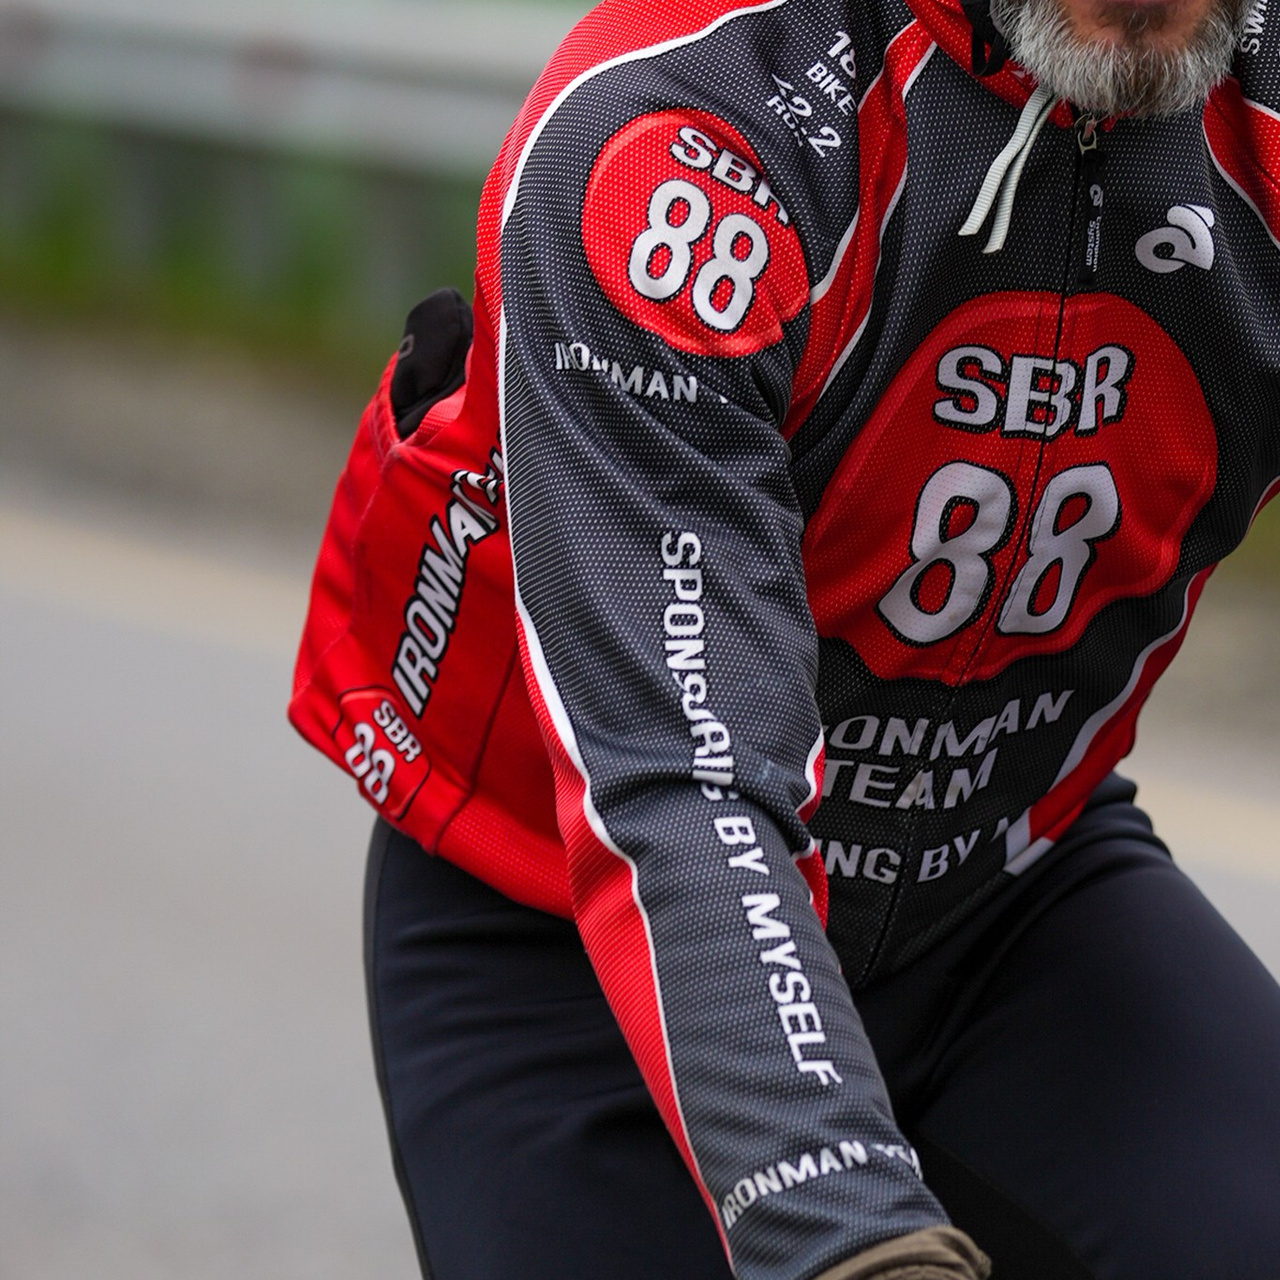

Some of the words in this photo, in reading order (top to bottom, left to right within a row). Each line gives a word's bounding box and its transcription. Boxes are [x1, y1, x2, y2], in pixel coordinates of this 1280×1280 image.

[805, 61, 857, 116] BIKE
[627, 177, 771, 333] 88
[933, 344, 1134, 439] SBR
[876, 459, 1123, 646] 88
[372, 696, 424, 764] SBR
[819, 688, 1076, 764] ONMAN
[821, 749, 1000, 814] TEAM
[713, 815, 771, 876] BY
[916, 828, 982, 884] BY
[741, 892, 844, 1088] MYSELF
[721, 1140, 869, 1230] IRONMAN
